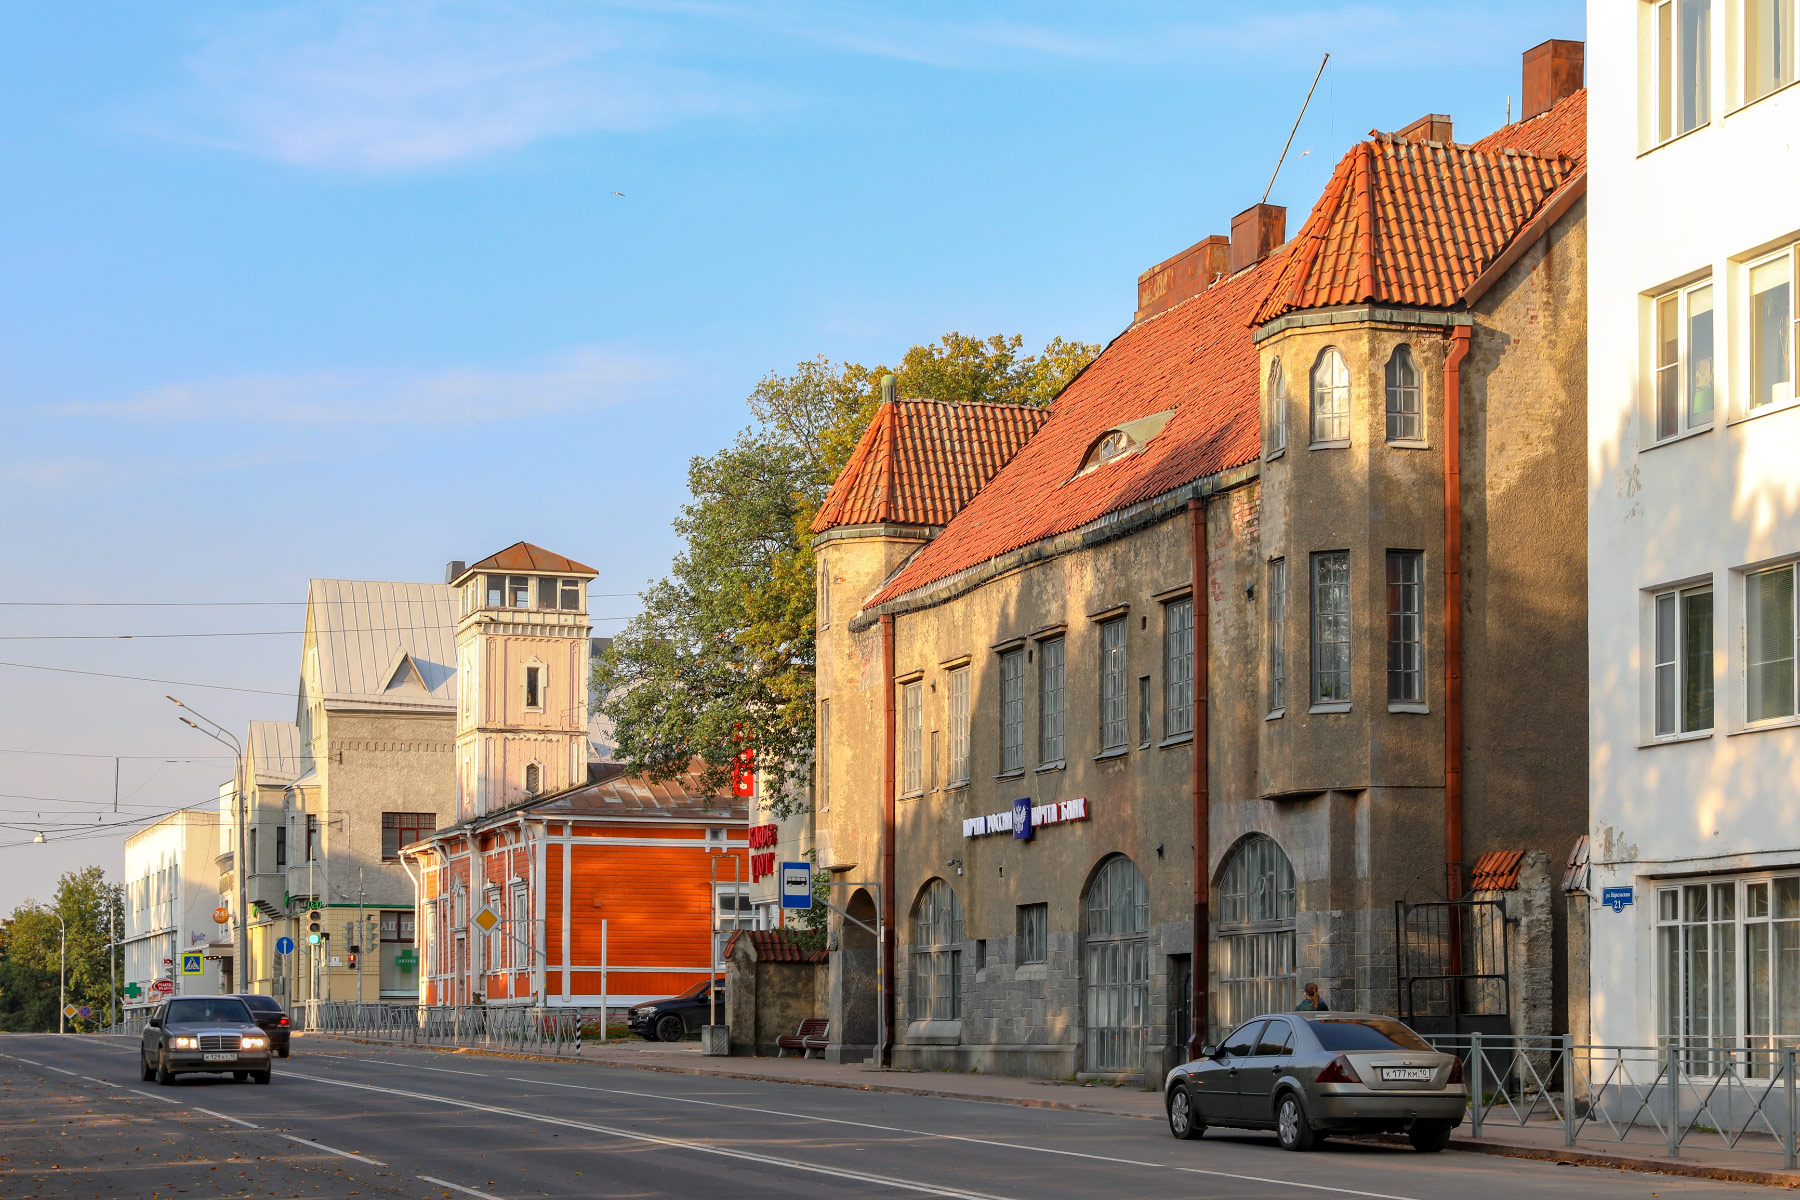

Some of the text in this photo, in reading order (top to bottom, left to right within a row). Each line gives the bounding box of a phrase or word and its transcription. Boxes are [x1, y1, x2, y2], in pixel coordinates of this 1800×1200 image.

[1061, 797, 1087, 821] БАНК
[1613, 900, 1621, 909] 21
[380, 921, 416, 931] АПТЕ
